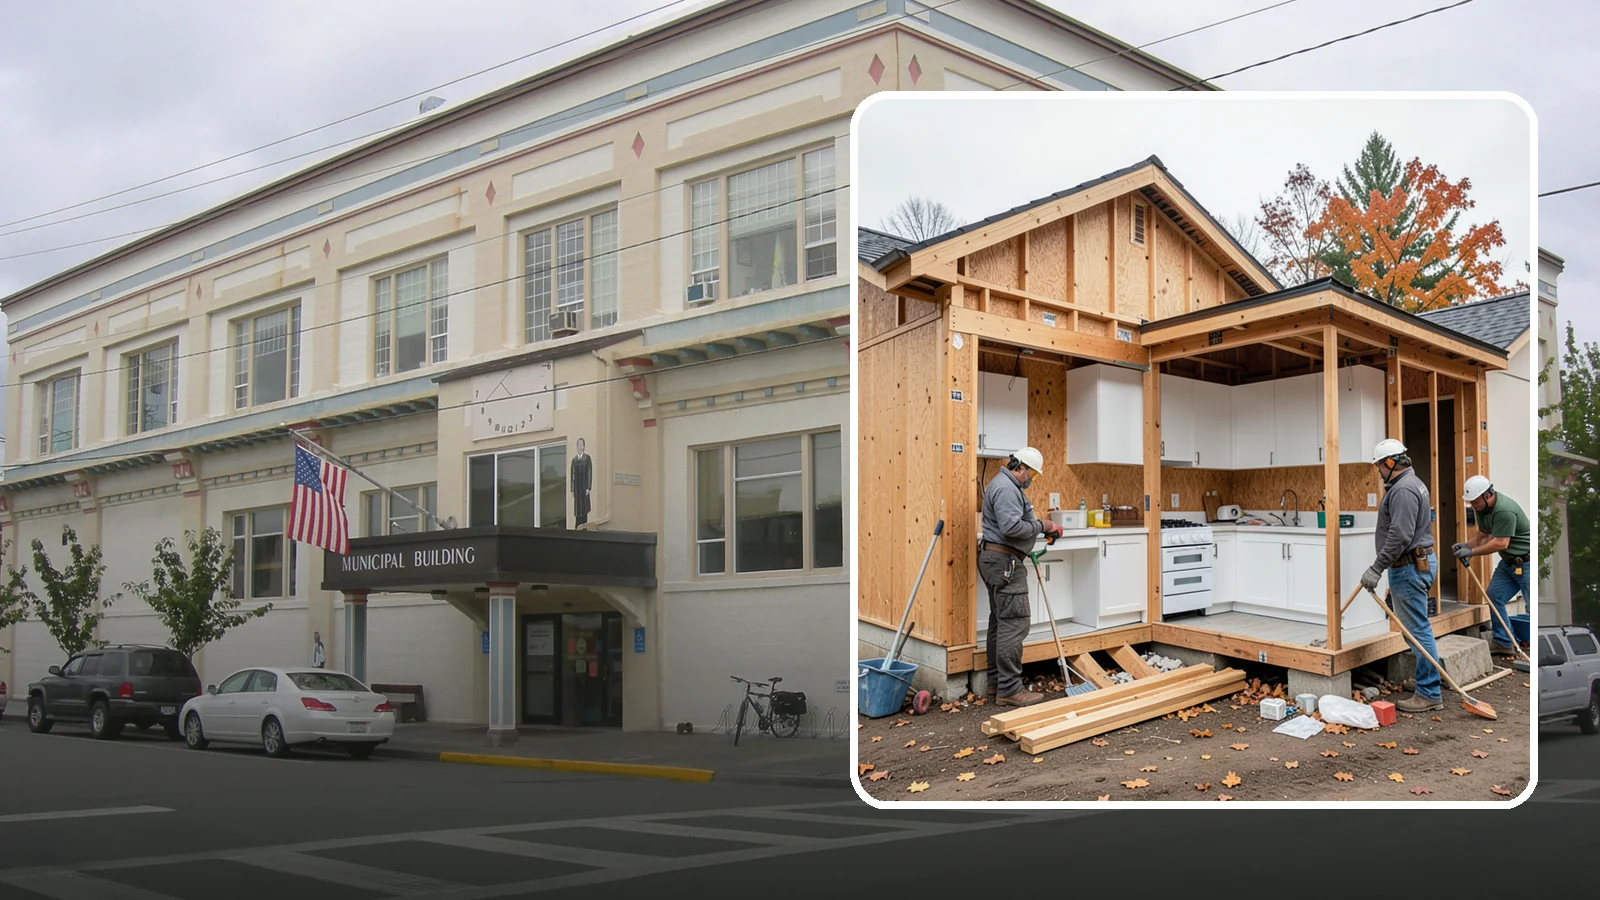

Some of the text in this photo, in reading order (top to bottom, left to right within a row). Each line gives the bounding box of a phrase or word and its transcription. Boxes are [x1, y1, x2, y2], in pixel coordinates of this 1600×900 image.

[536, 402, 540, 410] 4
[480, 406, 484, 415] 8
[488, 418, 492, 426] 9
[528, 414, 532, 422] 3
[495, 424, 500, 432] 10
[508, 426, 513, 434] 12
[342, 546, 475, 571] MUNICIPAL BUILDING
